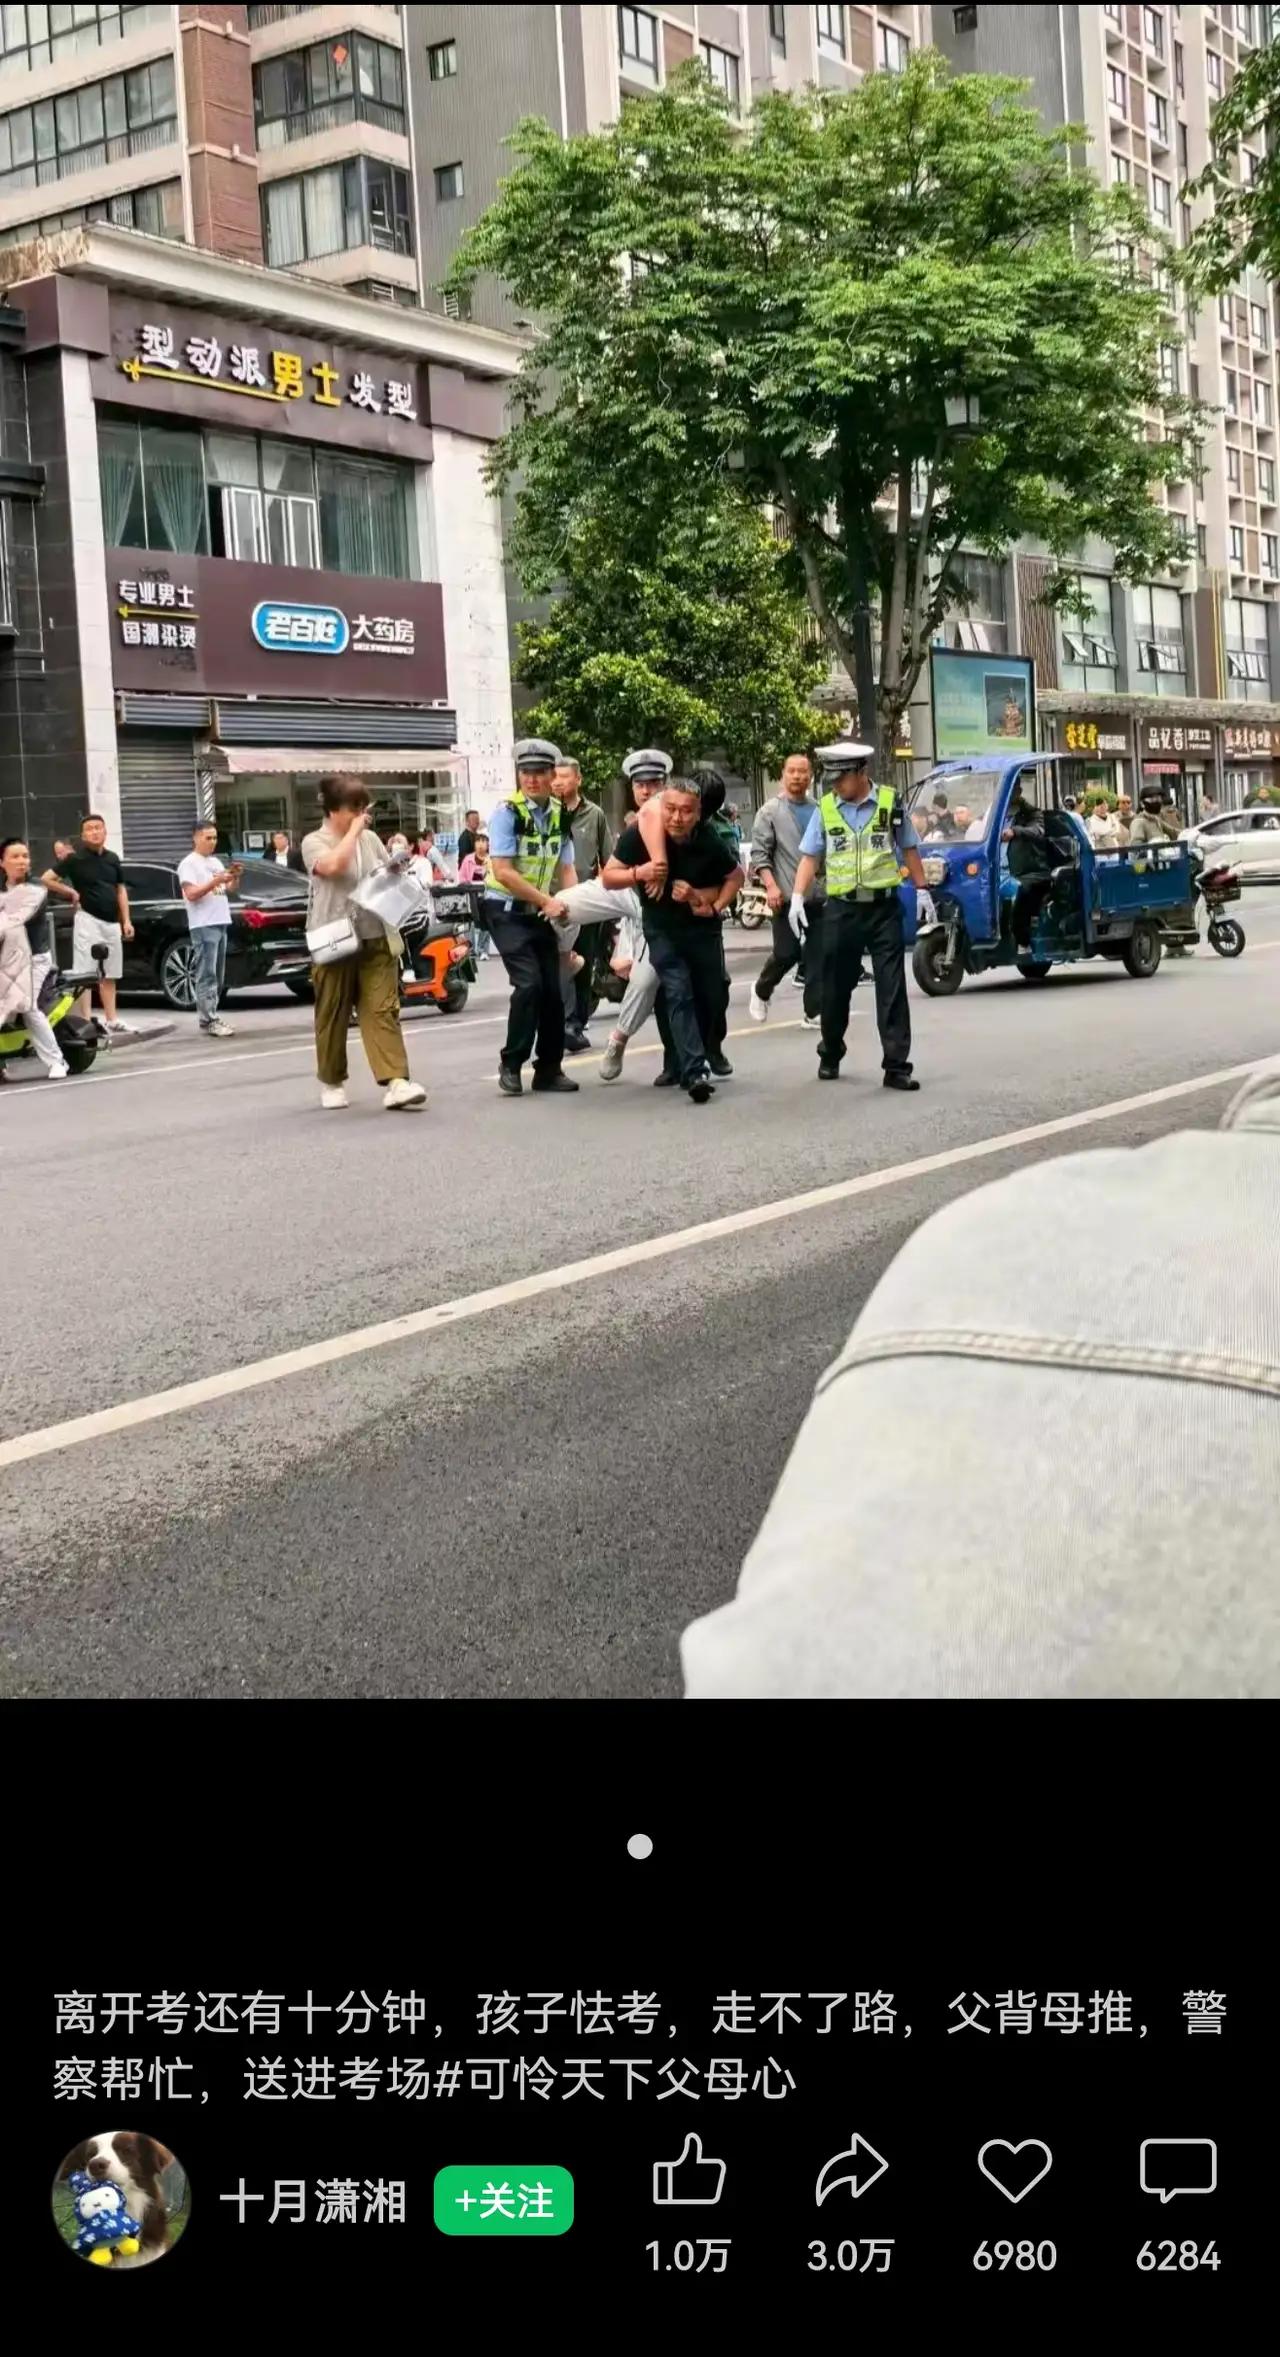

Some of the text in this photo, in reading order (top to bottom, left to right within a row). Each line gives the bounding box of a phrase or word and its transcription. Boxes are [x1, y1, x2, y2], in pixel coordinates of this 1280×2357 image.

[142, 324, 417, 421] 型动派男士发型
[119, 579, 195, 608] 专业男士
[352, 613, 415, 644] 大药房
